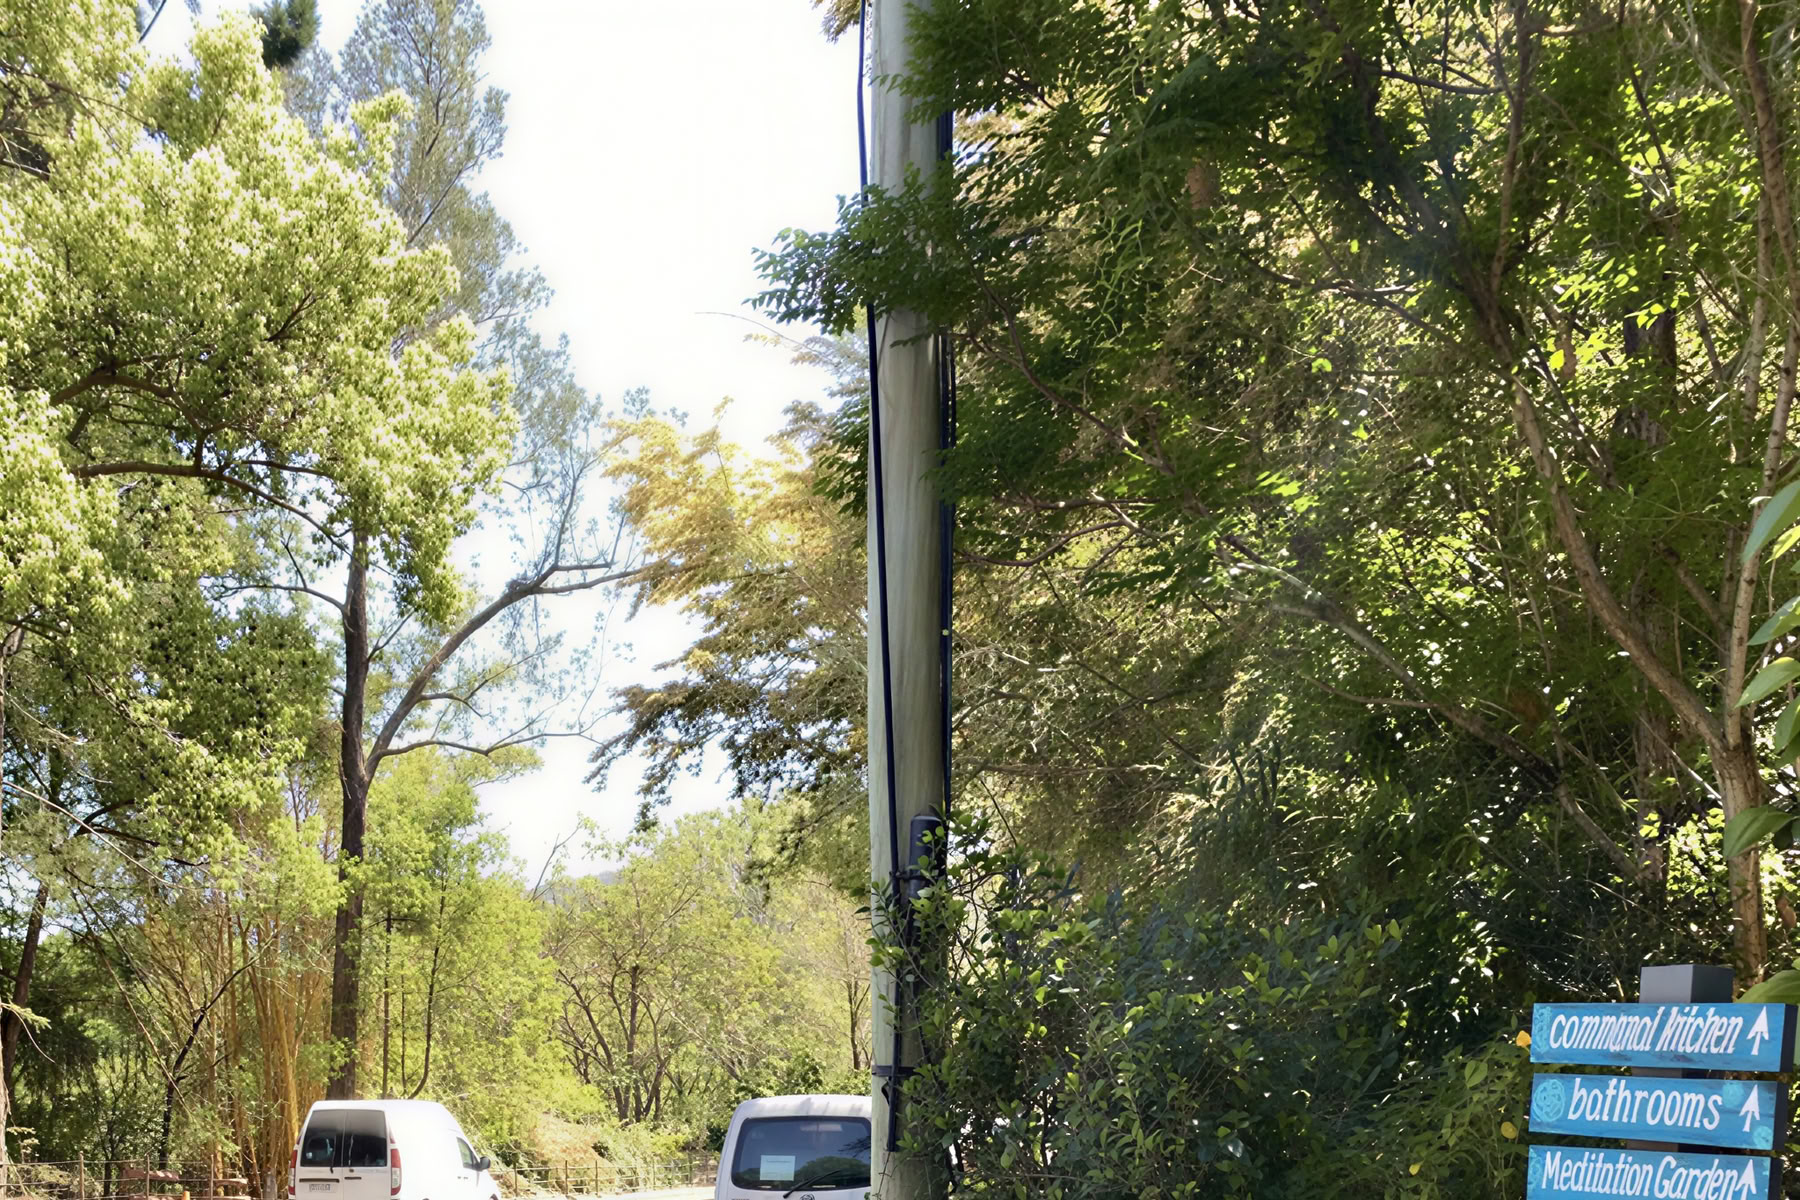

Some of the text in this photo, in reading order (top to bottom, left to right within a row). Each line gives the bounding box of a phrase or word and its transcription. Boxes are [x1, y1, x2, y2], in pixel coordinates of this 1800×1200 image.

[1655, 1006, 1744, 1054] kitchen
[1567, 1077, 1723, 1131] bathrooms
[1541, 1151, 1654, 1197] Meditation
